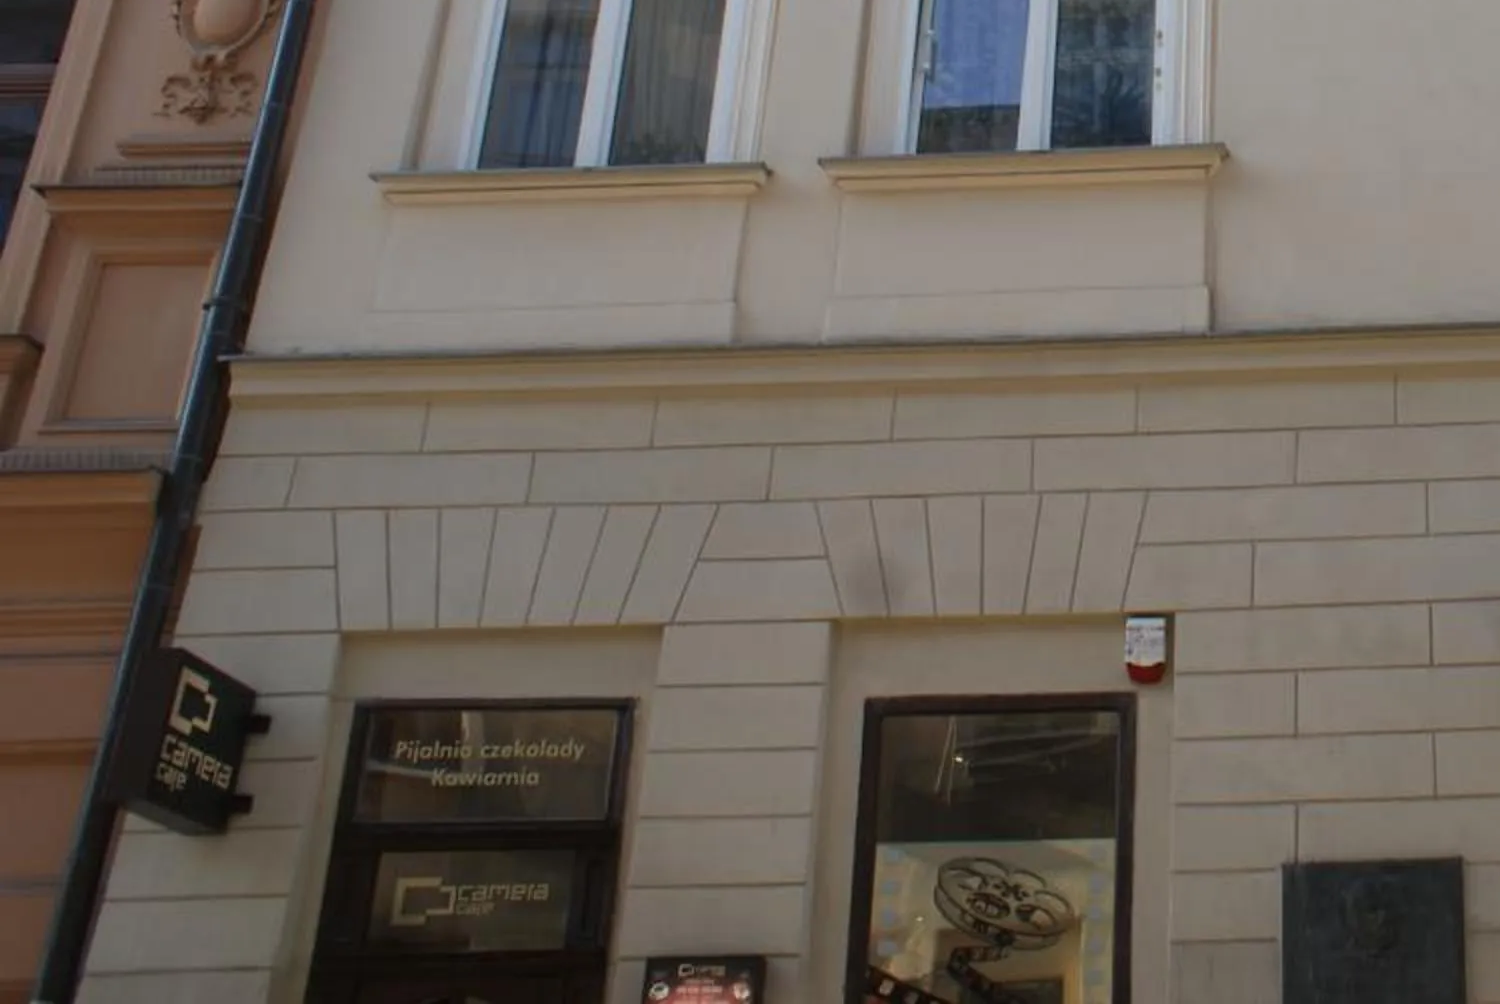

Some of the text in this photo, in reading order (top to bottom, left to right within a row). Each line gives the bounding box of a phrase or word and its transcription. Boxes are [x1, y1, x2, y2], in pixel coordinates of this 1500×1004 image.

[159, 733, 234, 790] camera
[394, 736, 586, 763] Pijalnia czekolady
[430, 765, 541, 787] Kawiarnia
[456, 882, 550, 901] camera
